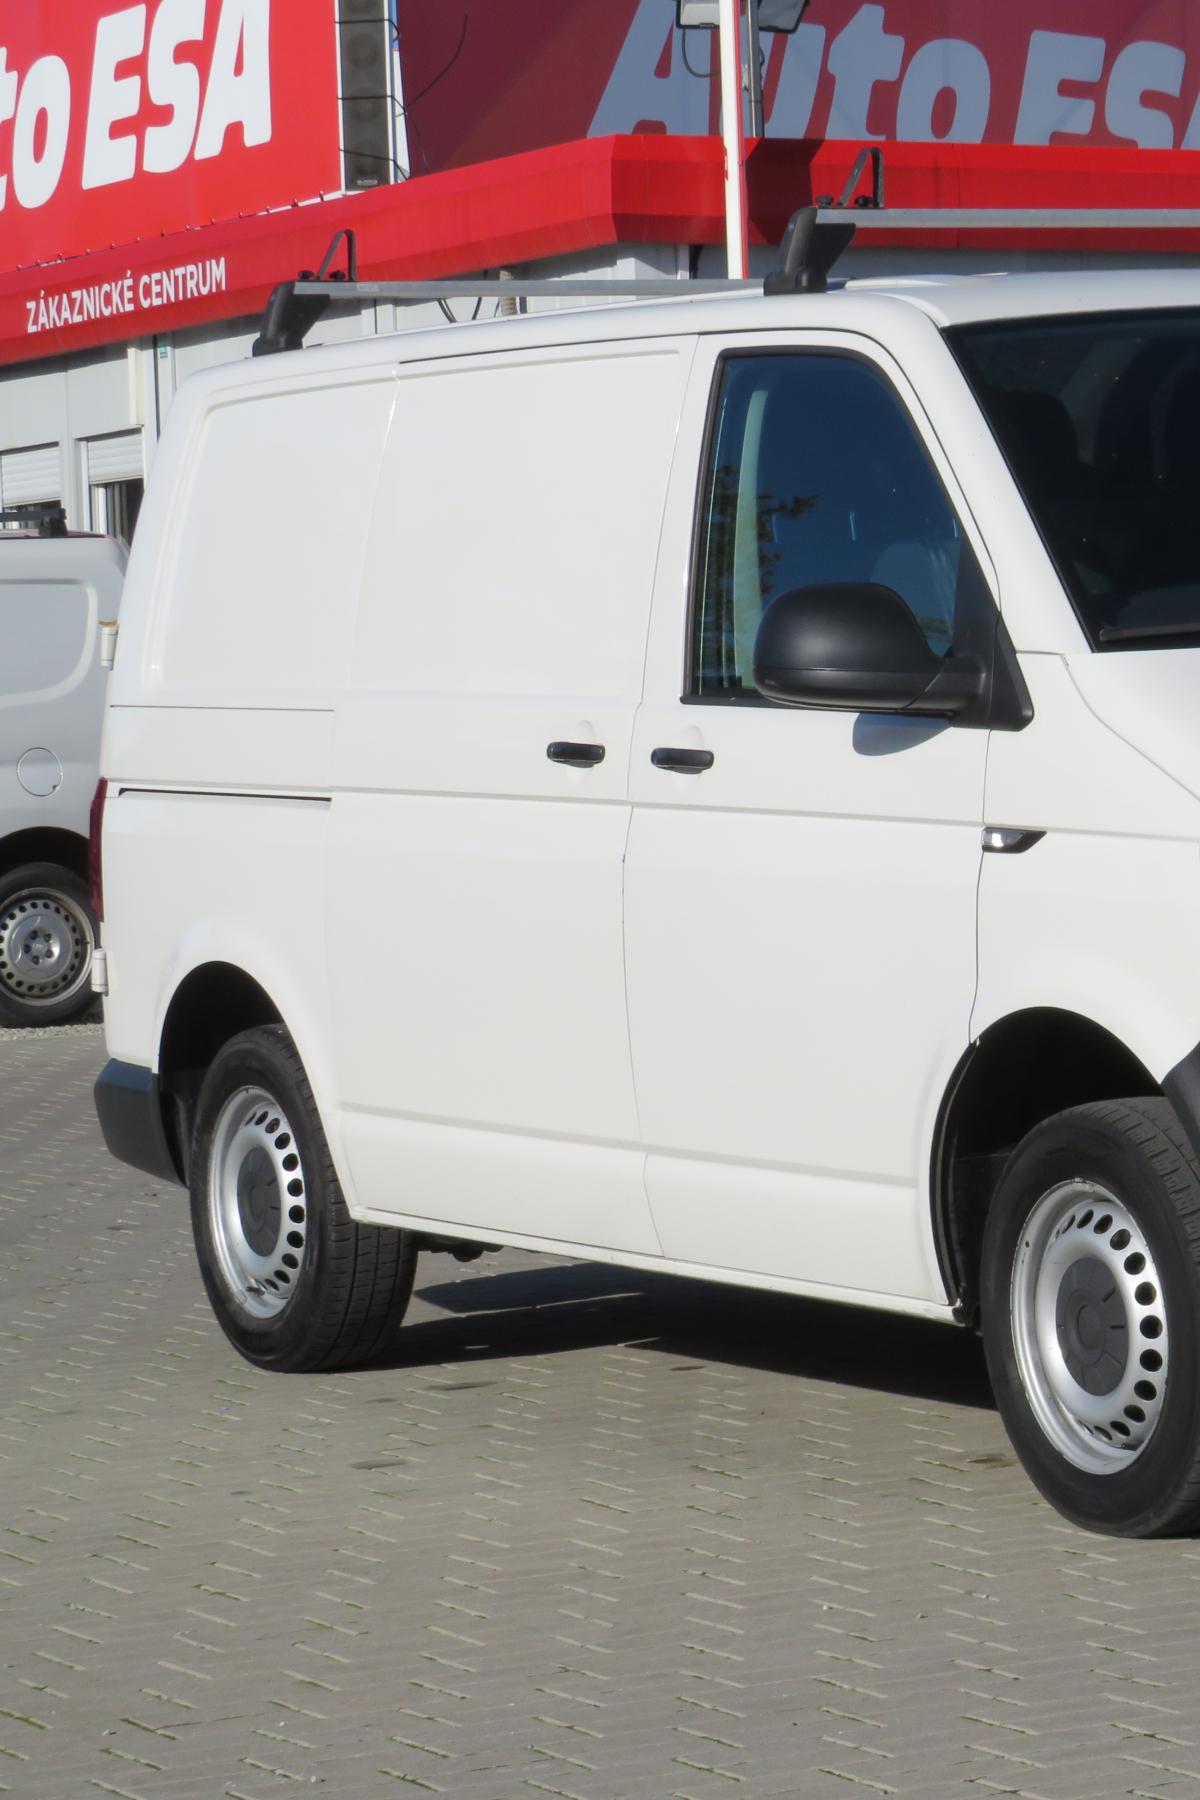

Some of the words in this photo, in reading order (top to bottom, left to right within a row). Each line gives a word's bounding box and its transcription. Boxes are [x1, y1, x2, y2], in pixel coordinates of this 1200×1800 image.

[82, 0, 272, 190] ESA
[587, 0, 991, 144] Auto
[26, 270, 135, 333] ZÁKAZNICKÉ
[139, 257, 226, 308] CENTRUM
